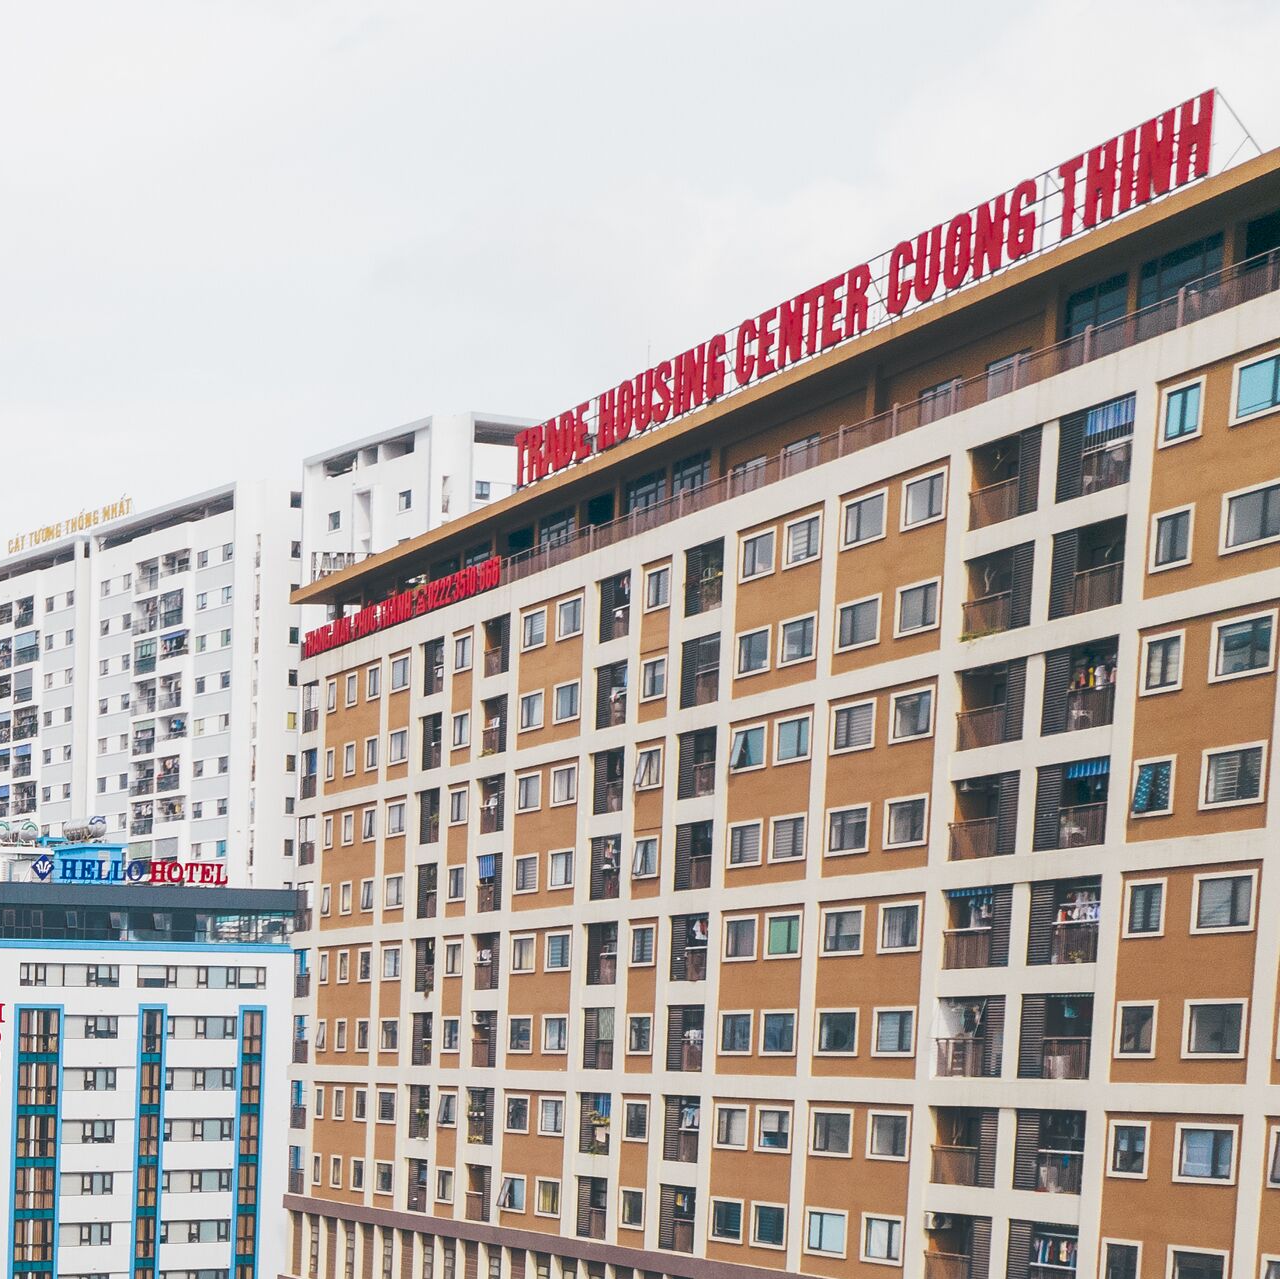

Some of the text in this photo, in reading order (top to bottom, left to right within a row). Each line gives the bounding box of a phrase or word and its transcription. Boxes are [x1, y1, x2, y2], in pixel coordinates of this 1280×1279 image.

[515, 88, 1215, 487] TRADE HOUSING CENTER CUONG THINH
[60, 858, 228, 885] HELLO HOTEL
